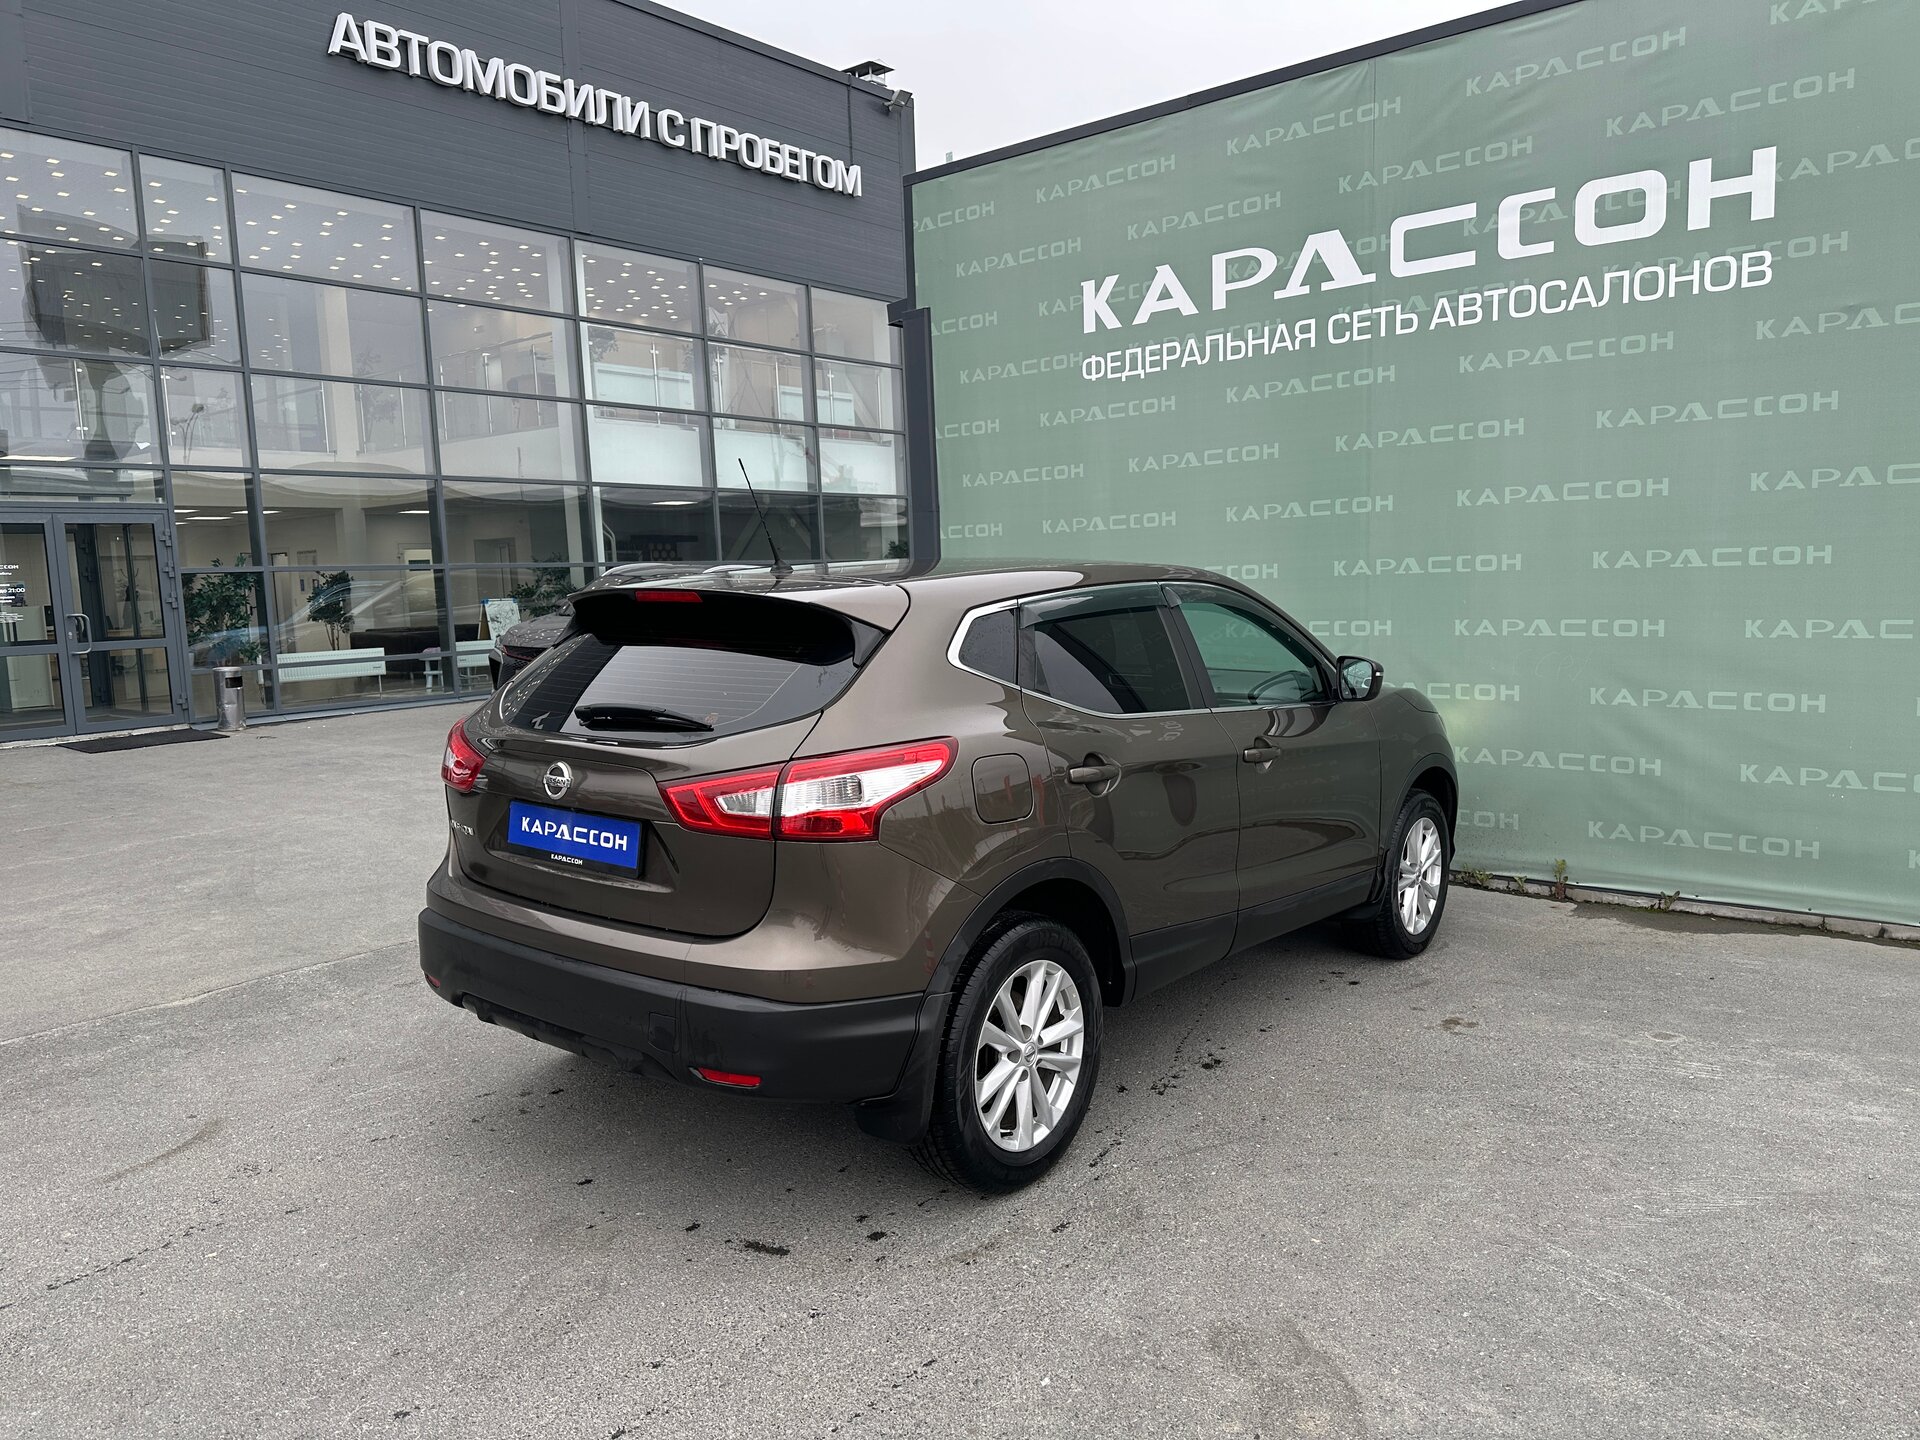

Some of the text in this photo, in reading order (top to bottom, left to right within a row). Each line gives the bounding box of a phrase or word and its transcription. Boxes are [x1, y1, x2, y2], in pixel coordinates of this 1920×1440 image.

[1466, 27, 1687, 96] КАРАССОН
[328, 12, 862, 197] АВТОМОБИЛИ С ПРОБЕГОМ
[1606, 68, 1856, 137] КАРАССОН
[1227, 96, 1402, 156] КАРАССОН
[1036, 154, 1176, 203] КАРАССОН
[1338, 136, 1533, 194] КАРАССОН
[1127, 191, 1282, 241] КАРАССОН
[956, 237, 1082, 278] КАРАССОН
[1081, 146, 1777, 334] КАРАССОН
[1082, 250, 1773, 381] ФЕДЕРАЛЬНАЯ СЕТЬ АВТОСАЛОНОВ
[1459, 331, 1674, 373] КАРАССОН
[1226, 365, 1396, 403] КАРАССОН
[1040, 395, 1176, 427] КАРАССОН
[1596, 390, 1839, 429] КАРАССОН
[1335, 418, 1525, 453] КАРАССОН
[962, 463, 1085, 488] КАРАССОН
[1128, 443, 1280, 473] КАРАССОН
[1226, 495, 1394, 523] КАРАССОН
[1456, 478, 1670, 507] КАРАССОН
[1042, 511, 1177, 534] КАРАССОН
[1333, 553, 1522, 577] КАРАССОН
[1592, 545, 1833, 569] КАРАССОН
[1454, 619, 1665, 638] КАРАССОН
[1590, 687, 1827, 714] КАРАССОН
[1454, 746, 1662, 777] КАРАССОН
[1739, 763, 1920, 793] КАРАС
[521, 816, 628, 852] КАРАССОН
[1588, 821, 1820, 860] КАРАССОН
